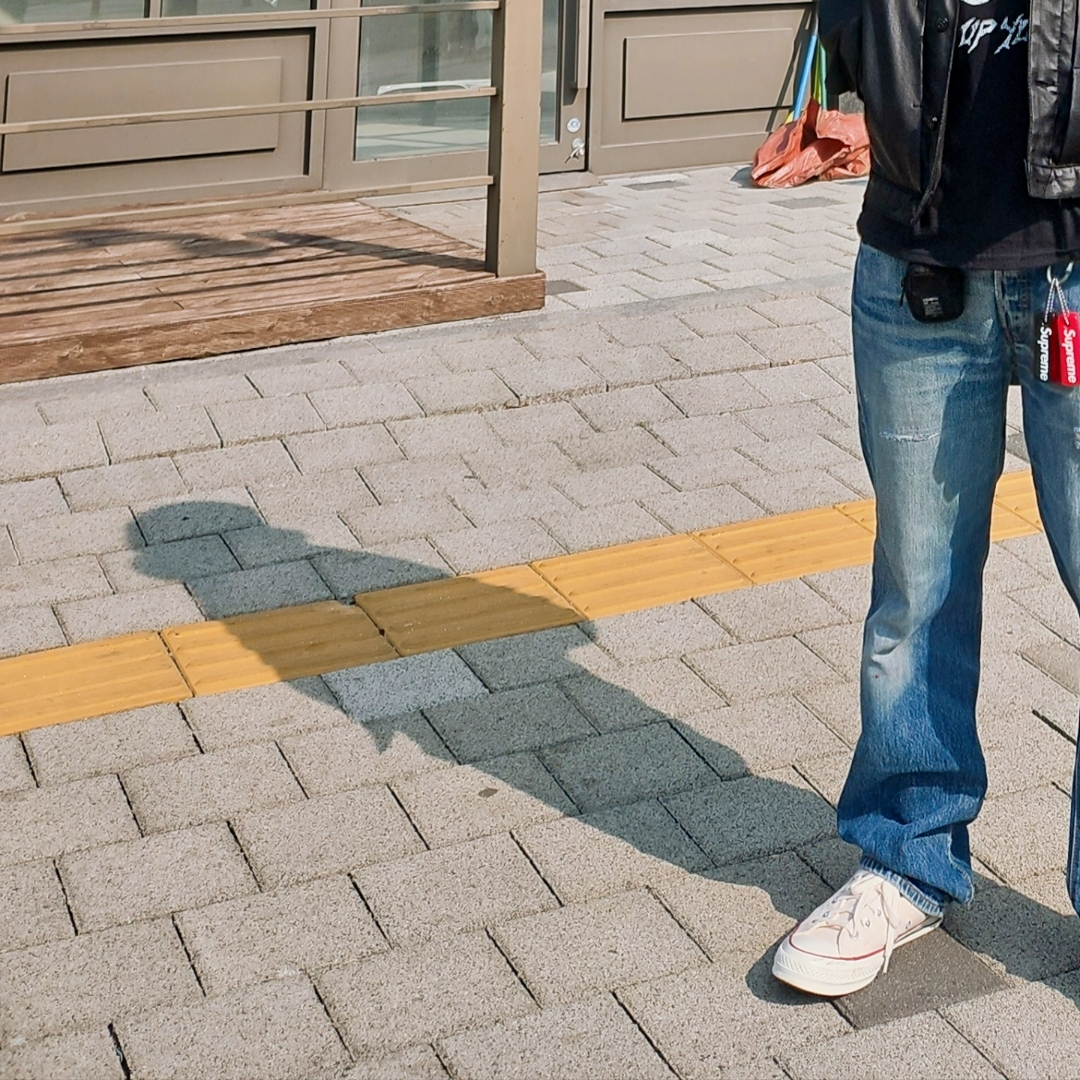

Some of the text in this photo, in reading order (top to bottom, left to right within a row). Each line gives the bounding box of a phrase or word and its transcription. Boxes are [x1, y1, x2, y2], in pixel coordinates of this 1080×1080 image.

[958, 16, 998, 54] UP
[1037, 326, 1052, 382] Supreme
[1062, 328, 1077, 384] Supreme
